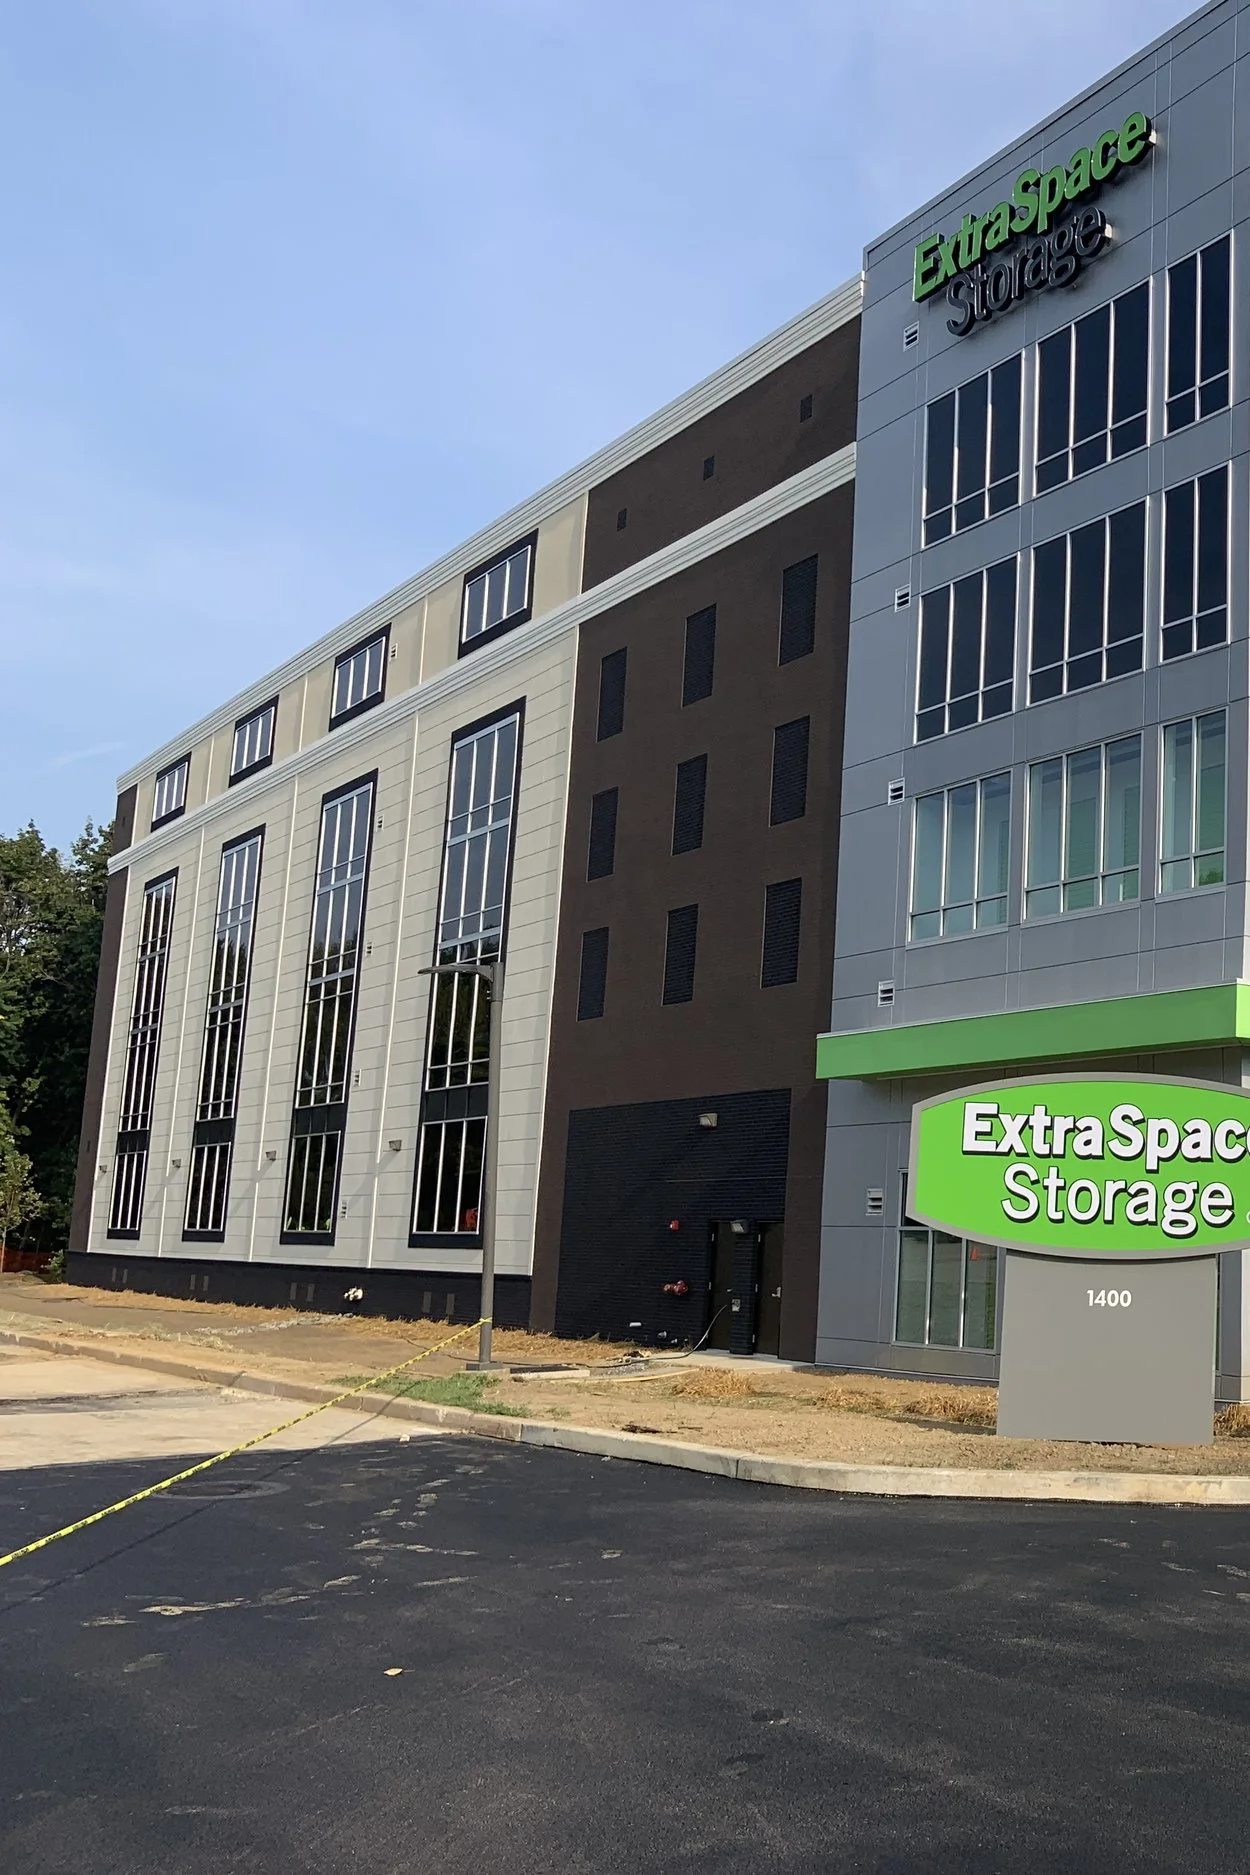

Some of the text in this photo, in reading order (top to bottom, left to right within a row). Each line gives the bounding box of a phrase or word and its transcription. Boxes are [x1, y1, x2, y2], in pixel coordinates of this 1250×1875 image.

[912, 111, 1151, 302] ExtraSpace
[946, 206, 1106, 336] Storage
[1001, 1163, 1235, 1239] Storage
[1086, 1289, 1132, 1308] 1400
